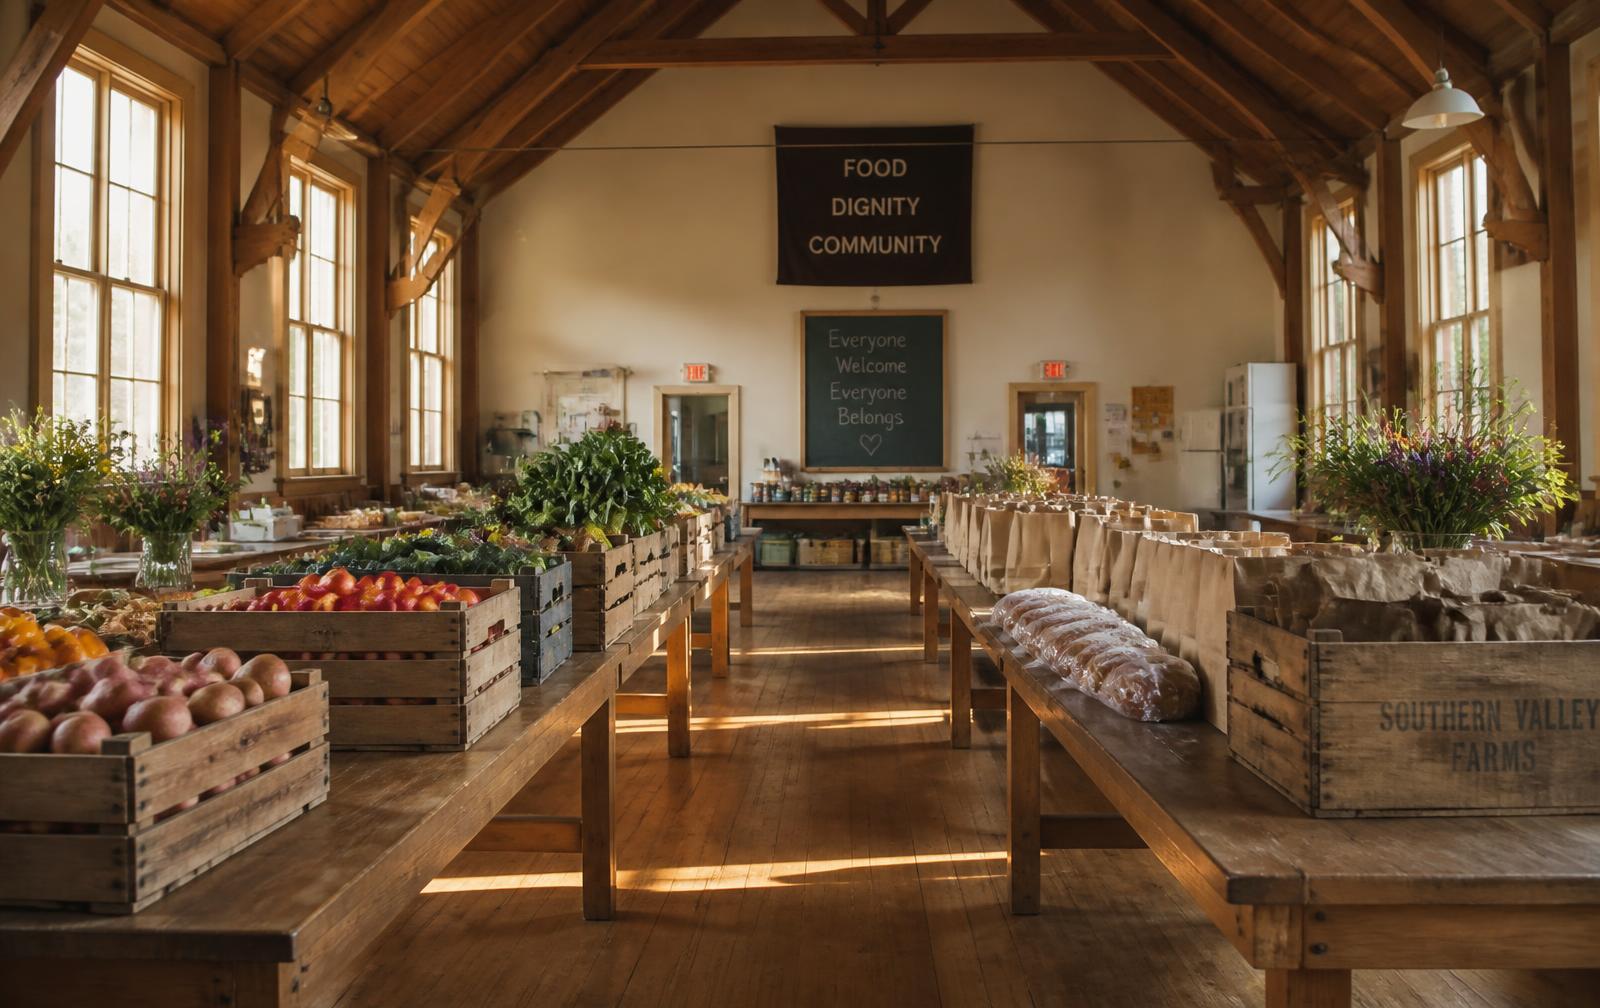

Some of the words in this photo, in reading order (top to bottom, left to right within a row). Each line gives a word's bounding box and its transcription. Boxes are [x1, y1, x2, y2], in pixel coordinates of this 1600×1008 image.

[843, 158, 908, 178] FOOD
[831, 196, 921, 217] DIGNITY
[808, 234, 943, 256] COMMUNITY
[828, 328, 908, 354] Everyone
[835, 355, 908, 374] Welcome
[830, 381, 908, 406] Everyone
[837, 406, 905, 432] Belongs
[1379, 700, 1502, 732] SOUTHERN
[1514, 697, 1600, 731] VALLEY
[1452, 740, 1536, 773] FARMS
